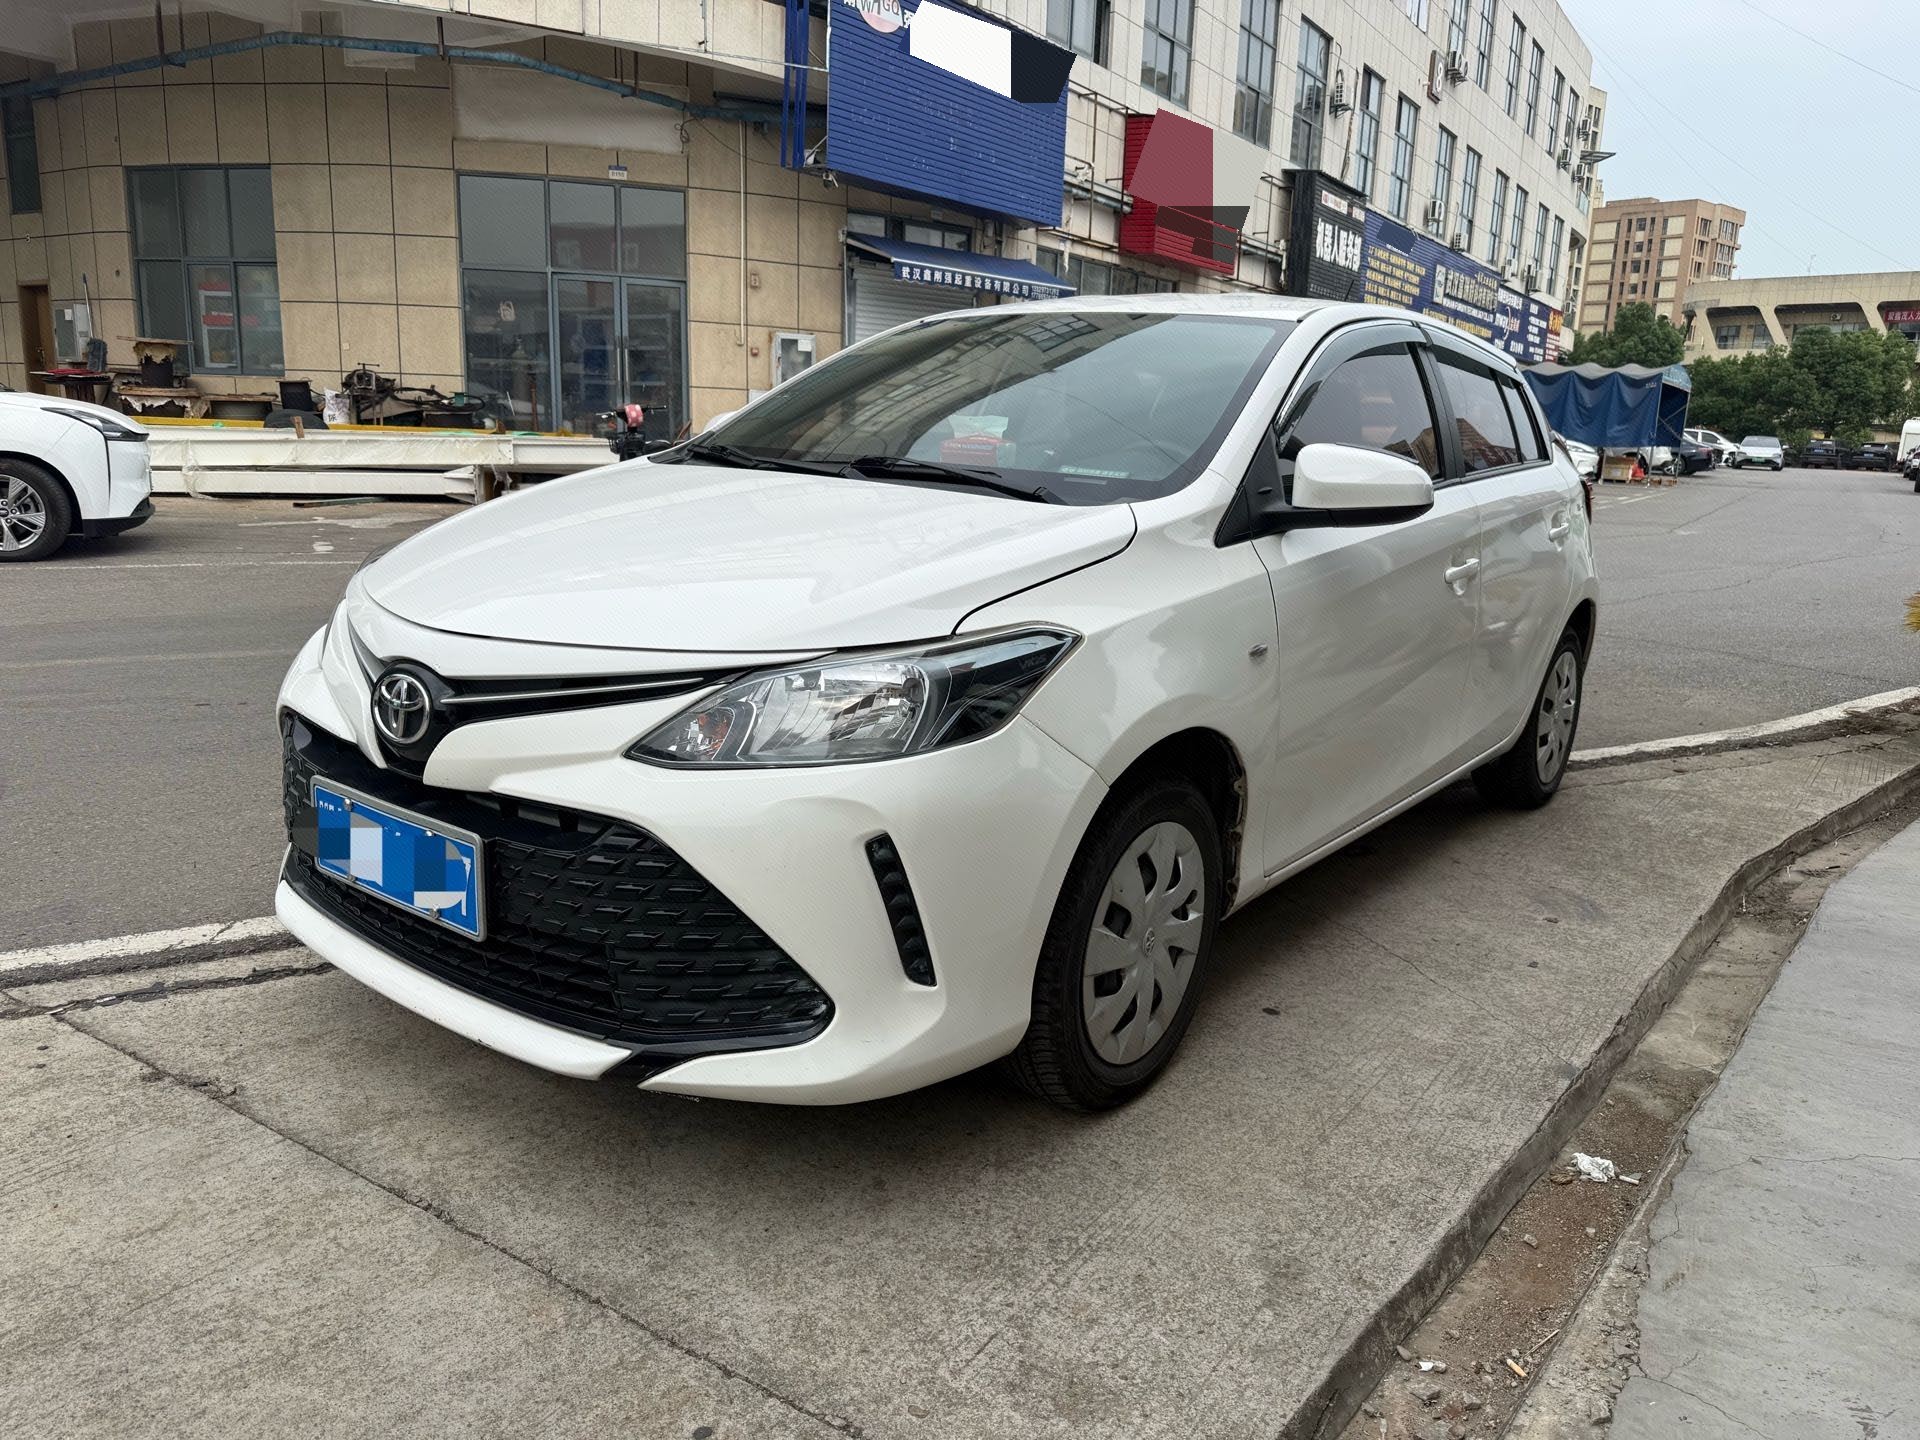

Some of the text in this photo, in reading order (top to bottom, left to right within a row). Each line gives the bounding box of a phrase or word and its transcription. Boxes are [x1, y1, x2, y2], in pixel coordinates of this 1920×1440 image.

[901, 266, 1029, 297] 武汉鑫刚强起重设备有限公司
